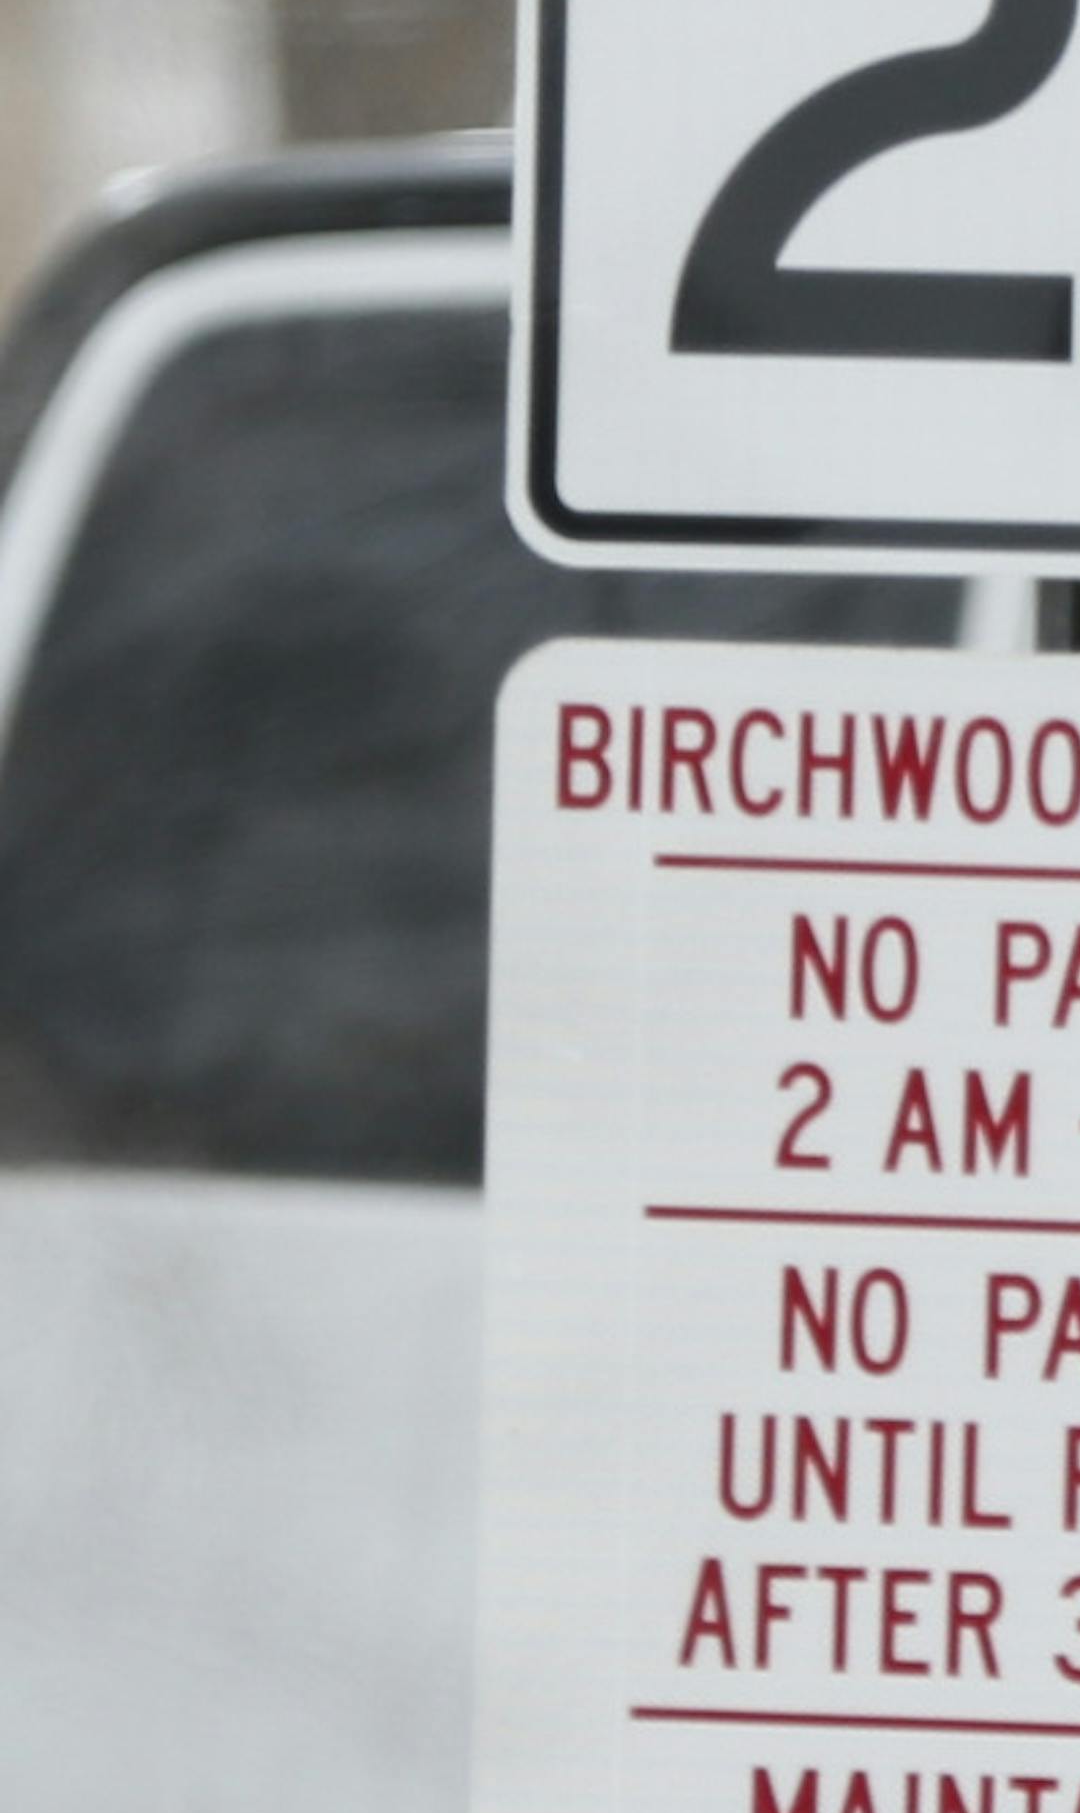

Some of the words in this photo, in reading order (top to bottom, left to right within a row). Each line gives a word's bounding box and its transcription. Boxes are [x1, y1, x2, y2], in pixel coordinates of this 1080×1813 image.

[791, 914, 920, 1024] NO
[775, 1062, 834, 1170] 2
[885, 1069, 1033, 1175] AM
[781, 1266, 910, 1376] NO
[718, 1415, 1012, 1530] UNTIL
[680, 1557, 1006, 1677] AFTER
